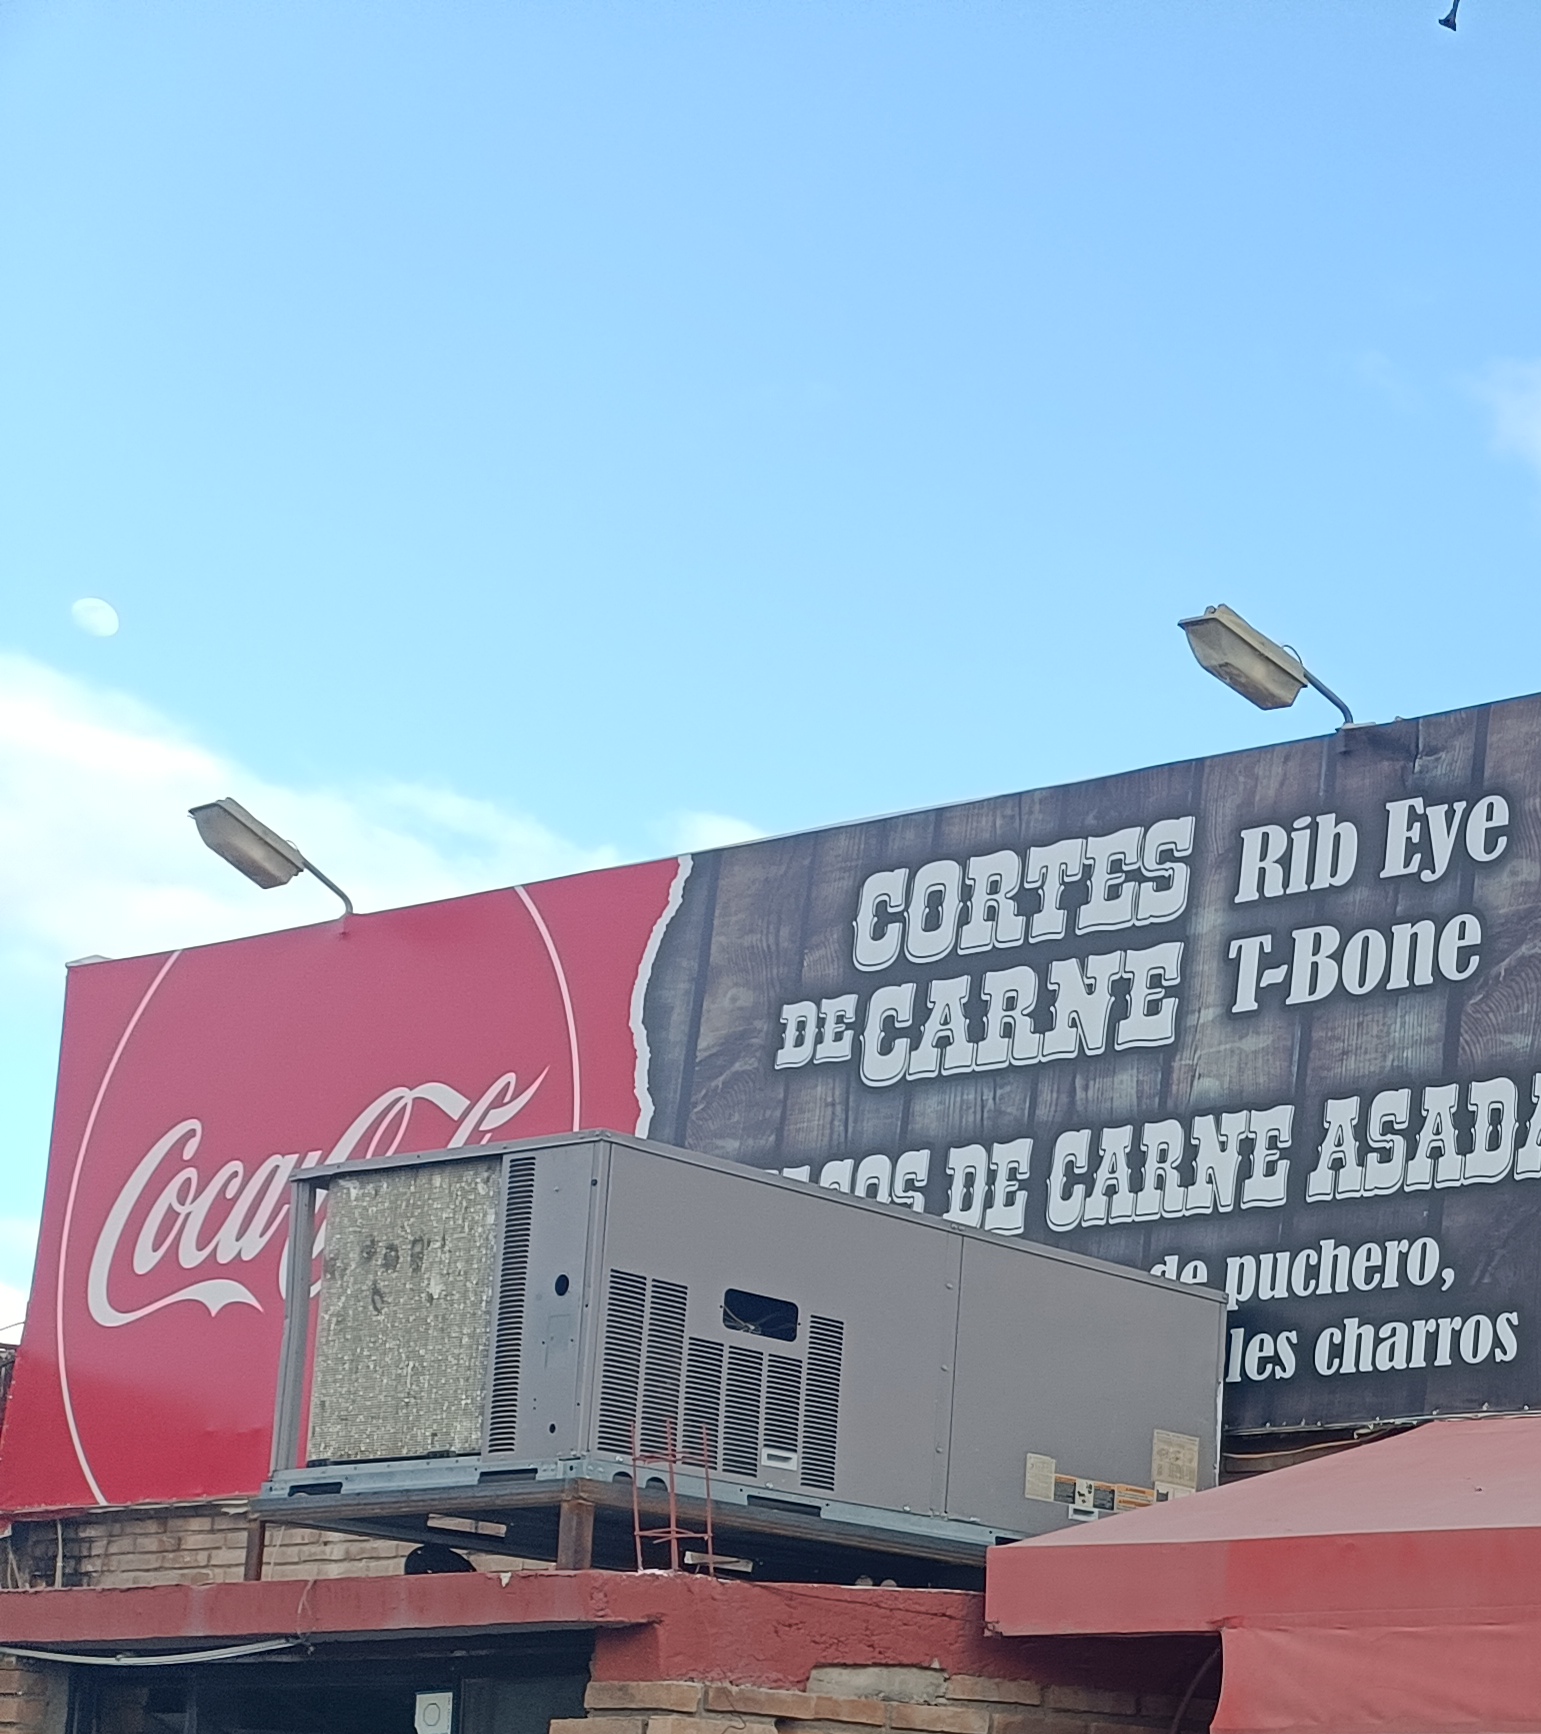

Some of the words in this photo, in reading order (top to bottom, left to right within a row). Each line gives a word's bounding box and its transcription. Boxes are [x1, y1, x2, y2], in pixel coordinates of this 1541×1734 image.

[852, 815, 1196, 972] CORTES
[1234, 812, 1359, 906] Rib
[1379, 794, 1511, 884] Eye
[774, 993, 857, 1071] DE
[859, 941, 1185, 1088] CARNE
[1227, 913, 1482, 1014] T-Bone
[942, 1137, 1033, 1235] DE
[1046, 1104, 1295, 1233] CARNE
[1225, 1236, 1455, 1310] puchero,
[1314, 1311, 1519, 1376] charros
